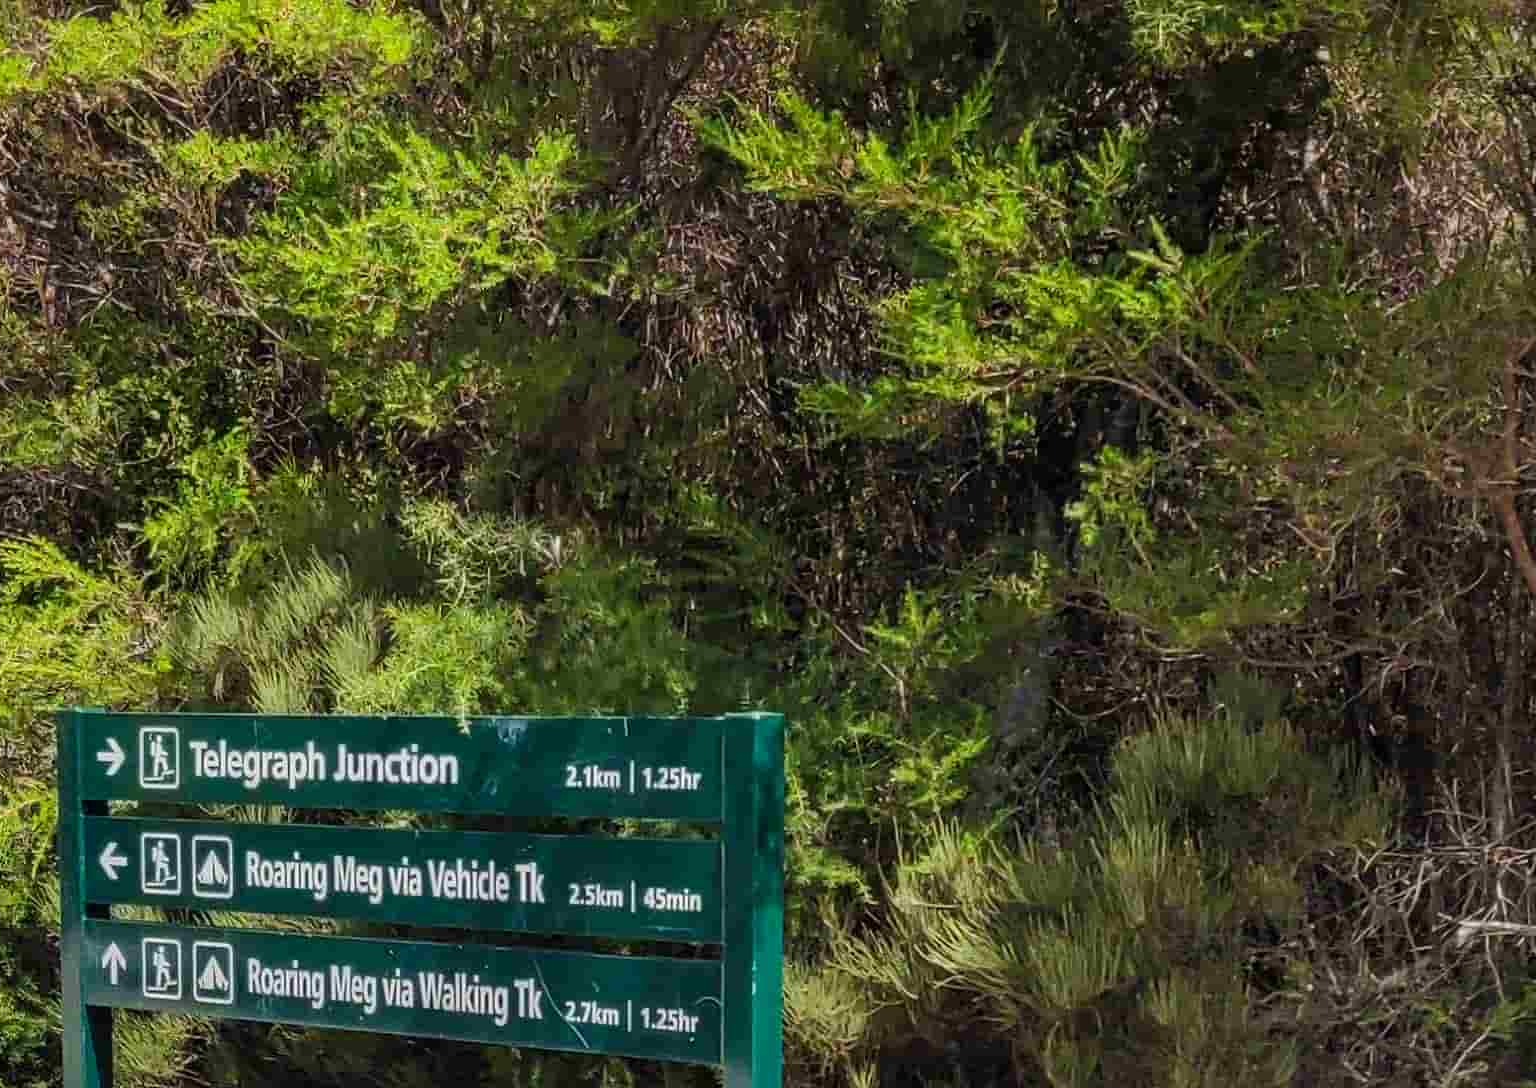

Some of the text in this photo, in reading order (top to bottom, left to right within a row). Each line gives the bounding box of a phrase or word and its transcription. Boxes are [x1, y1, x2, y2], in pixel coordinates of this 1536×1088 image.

[189, 739, 702, 790] Telegraph Junction 2.1km 1.25hr
[246, 850, 702, 912] Roaring Meg via Vehicle Tk 2.5km 45min
[247, 957, 699, 1033] Roaring Meg via Walking Tk 2.7km 1.25hr
